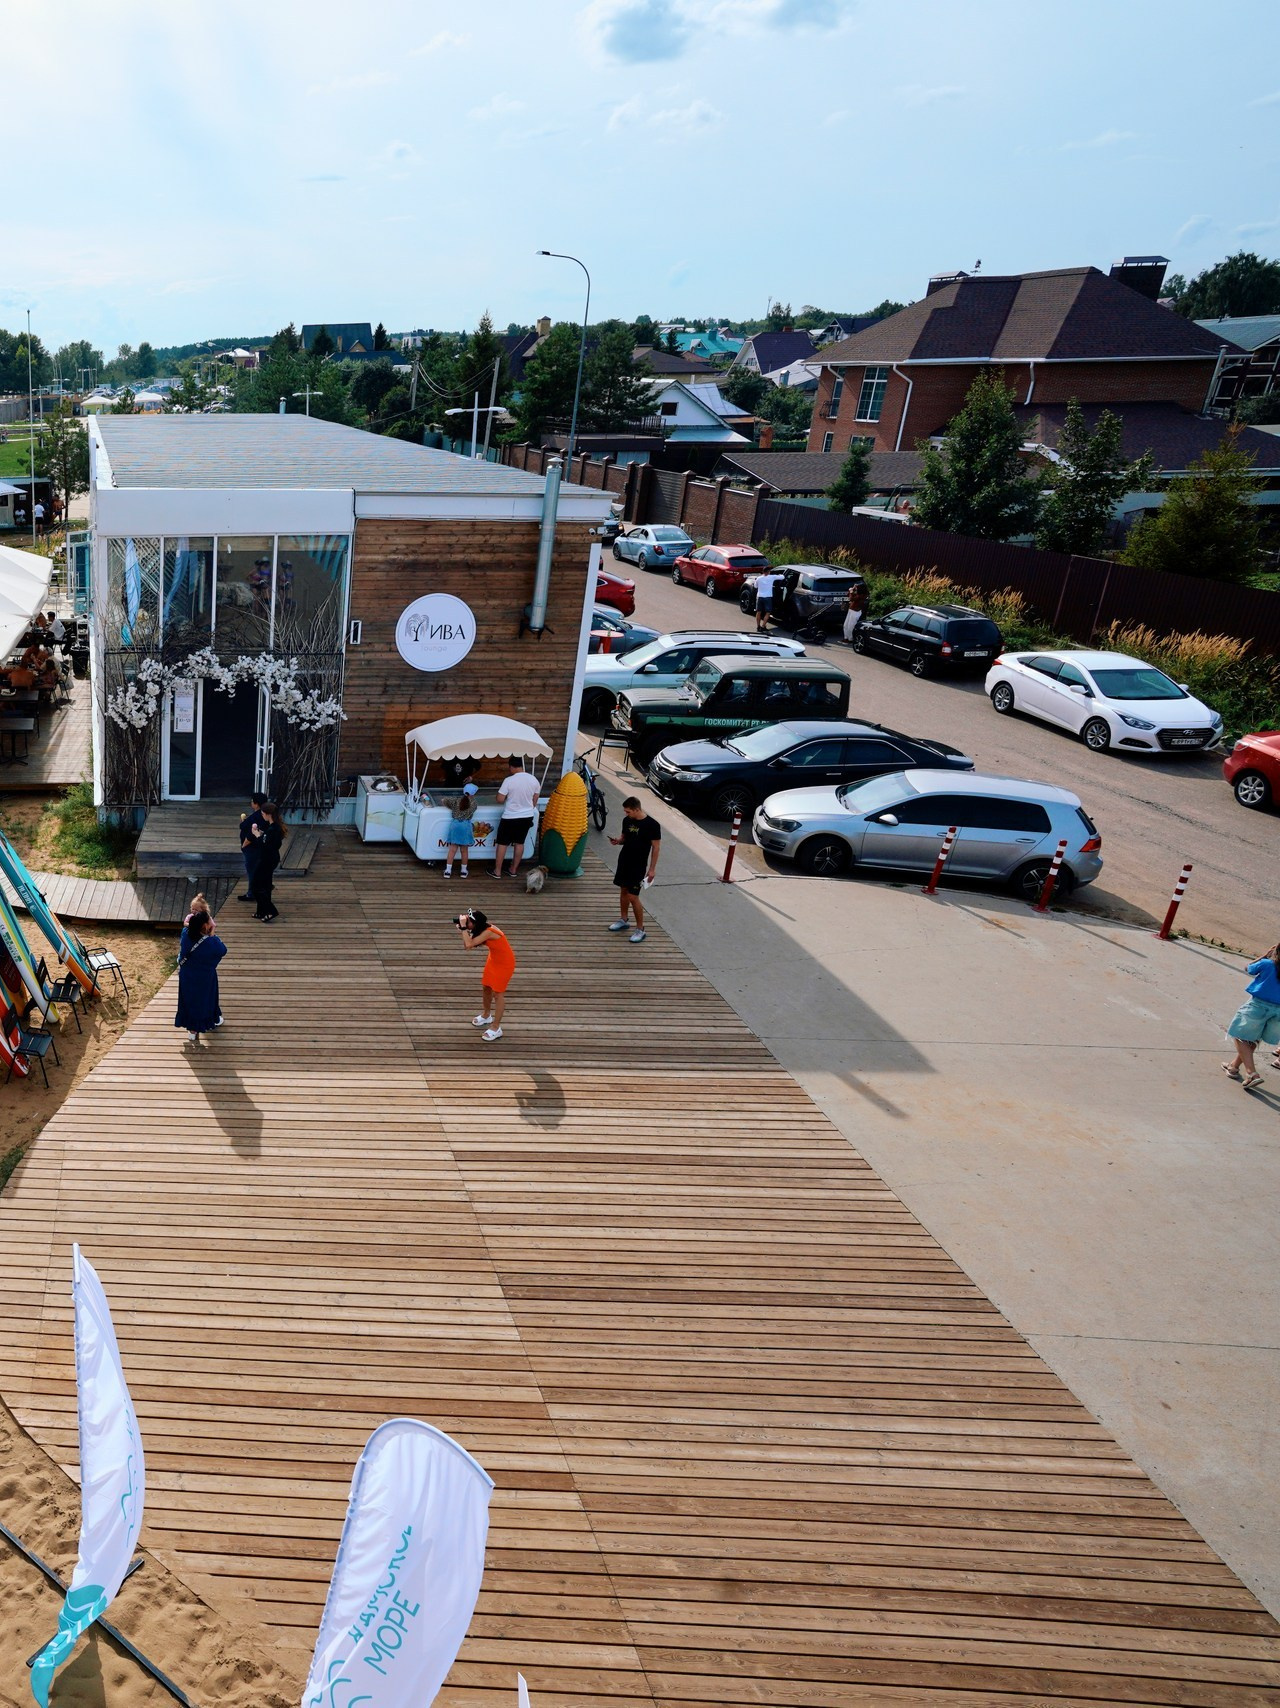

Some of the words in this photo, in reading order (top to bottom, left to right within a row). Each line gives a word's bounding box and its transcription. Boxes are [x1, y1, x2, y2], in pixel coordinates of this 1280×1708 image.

[430, 624, 465, 640] ИВА
[421, 645, 447, 653] lounge
[704, 718, 750, 727] ГОСКОМИТЕТ
[363, 1590, 421, 1676] МОРЕ
